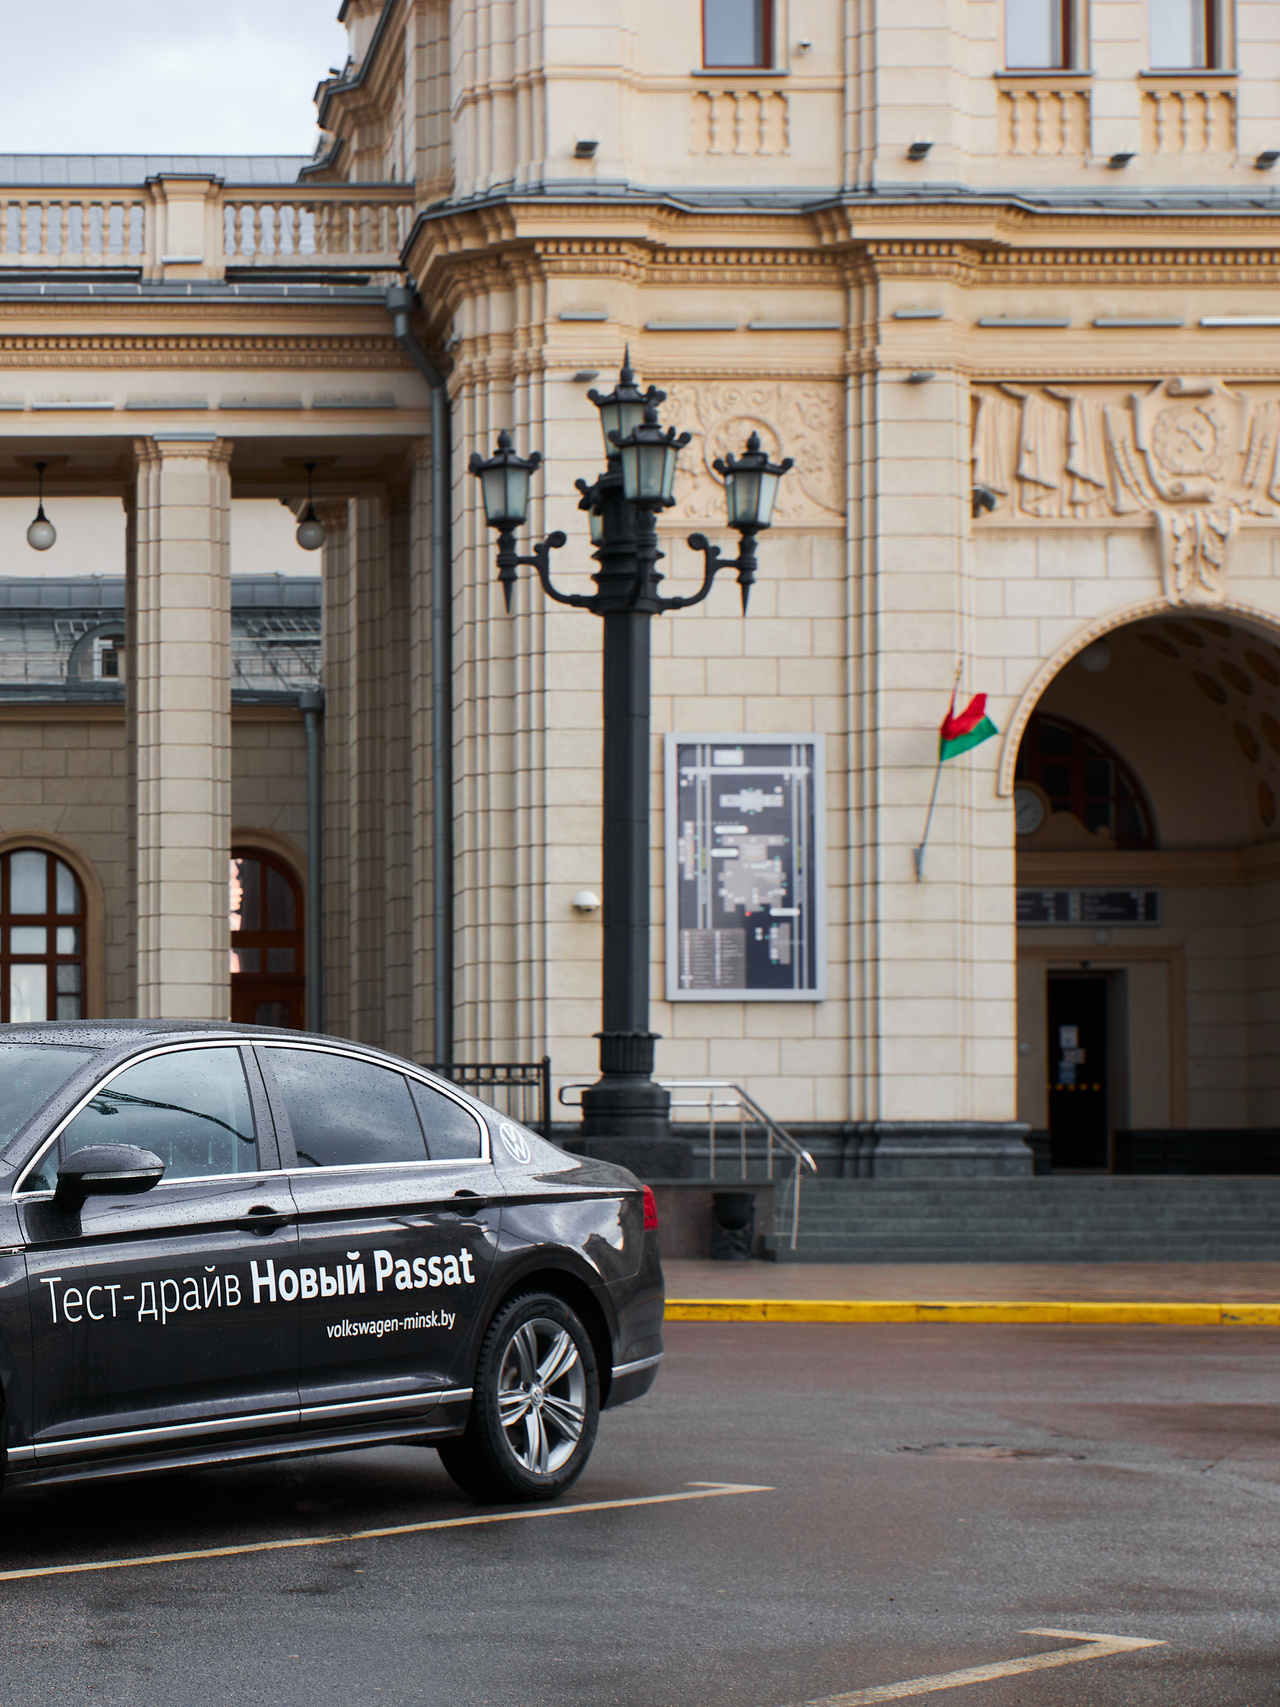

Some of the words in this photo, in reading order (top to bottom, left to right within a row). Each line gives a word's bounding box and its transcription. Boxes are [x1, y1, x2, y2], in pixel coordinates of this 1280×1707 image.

[40, 1265, 242, 1324] Тест-драйв
[249, 1250, 366, 1304] Новый
[373, 1247, 476, 1291] Passat
[326, 1309, 456, 1339] volkswagen-minsk.by
